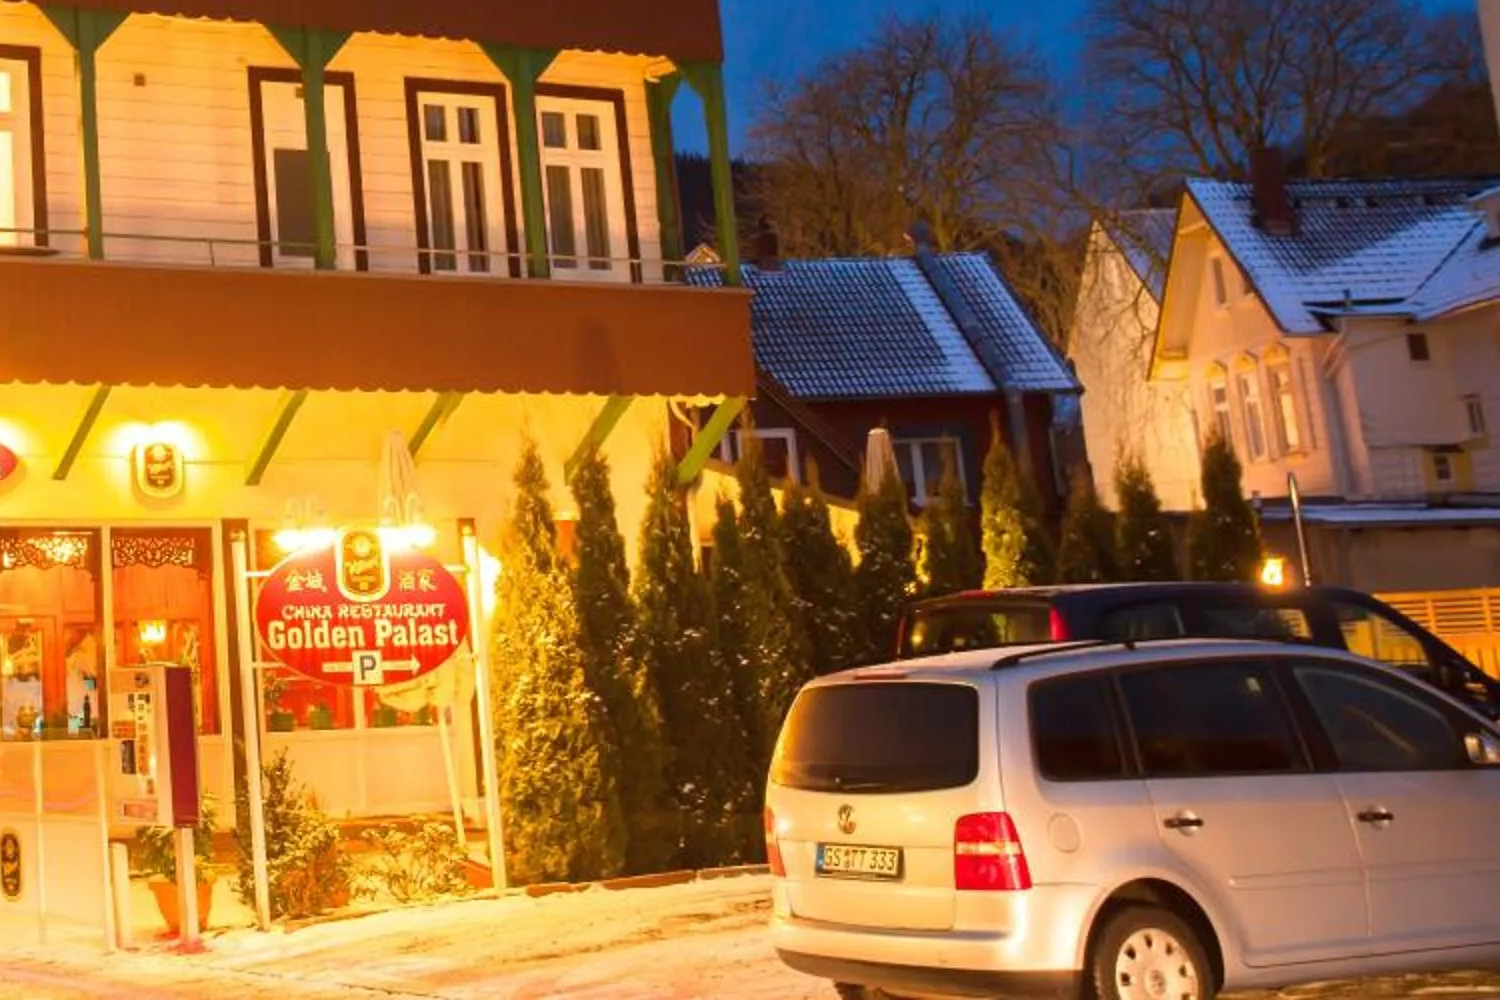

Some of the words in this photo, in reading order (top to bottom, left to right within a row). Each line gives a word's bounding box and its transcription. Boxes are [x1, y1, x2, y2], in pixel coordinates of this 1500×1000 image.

[281, 603, 333, 620] CHINA
[337, 602, 447, 620] RESTAURANT
[268, 618, 366, 649] Golden
[375, 618, 460, 647] Palast
[359, 655, 377, 681] P
[869, 850, 897, 871] 333
